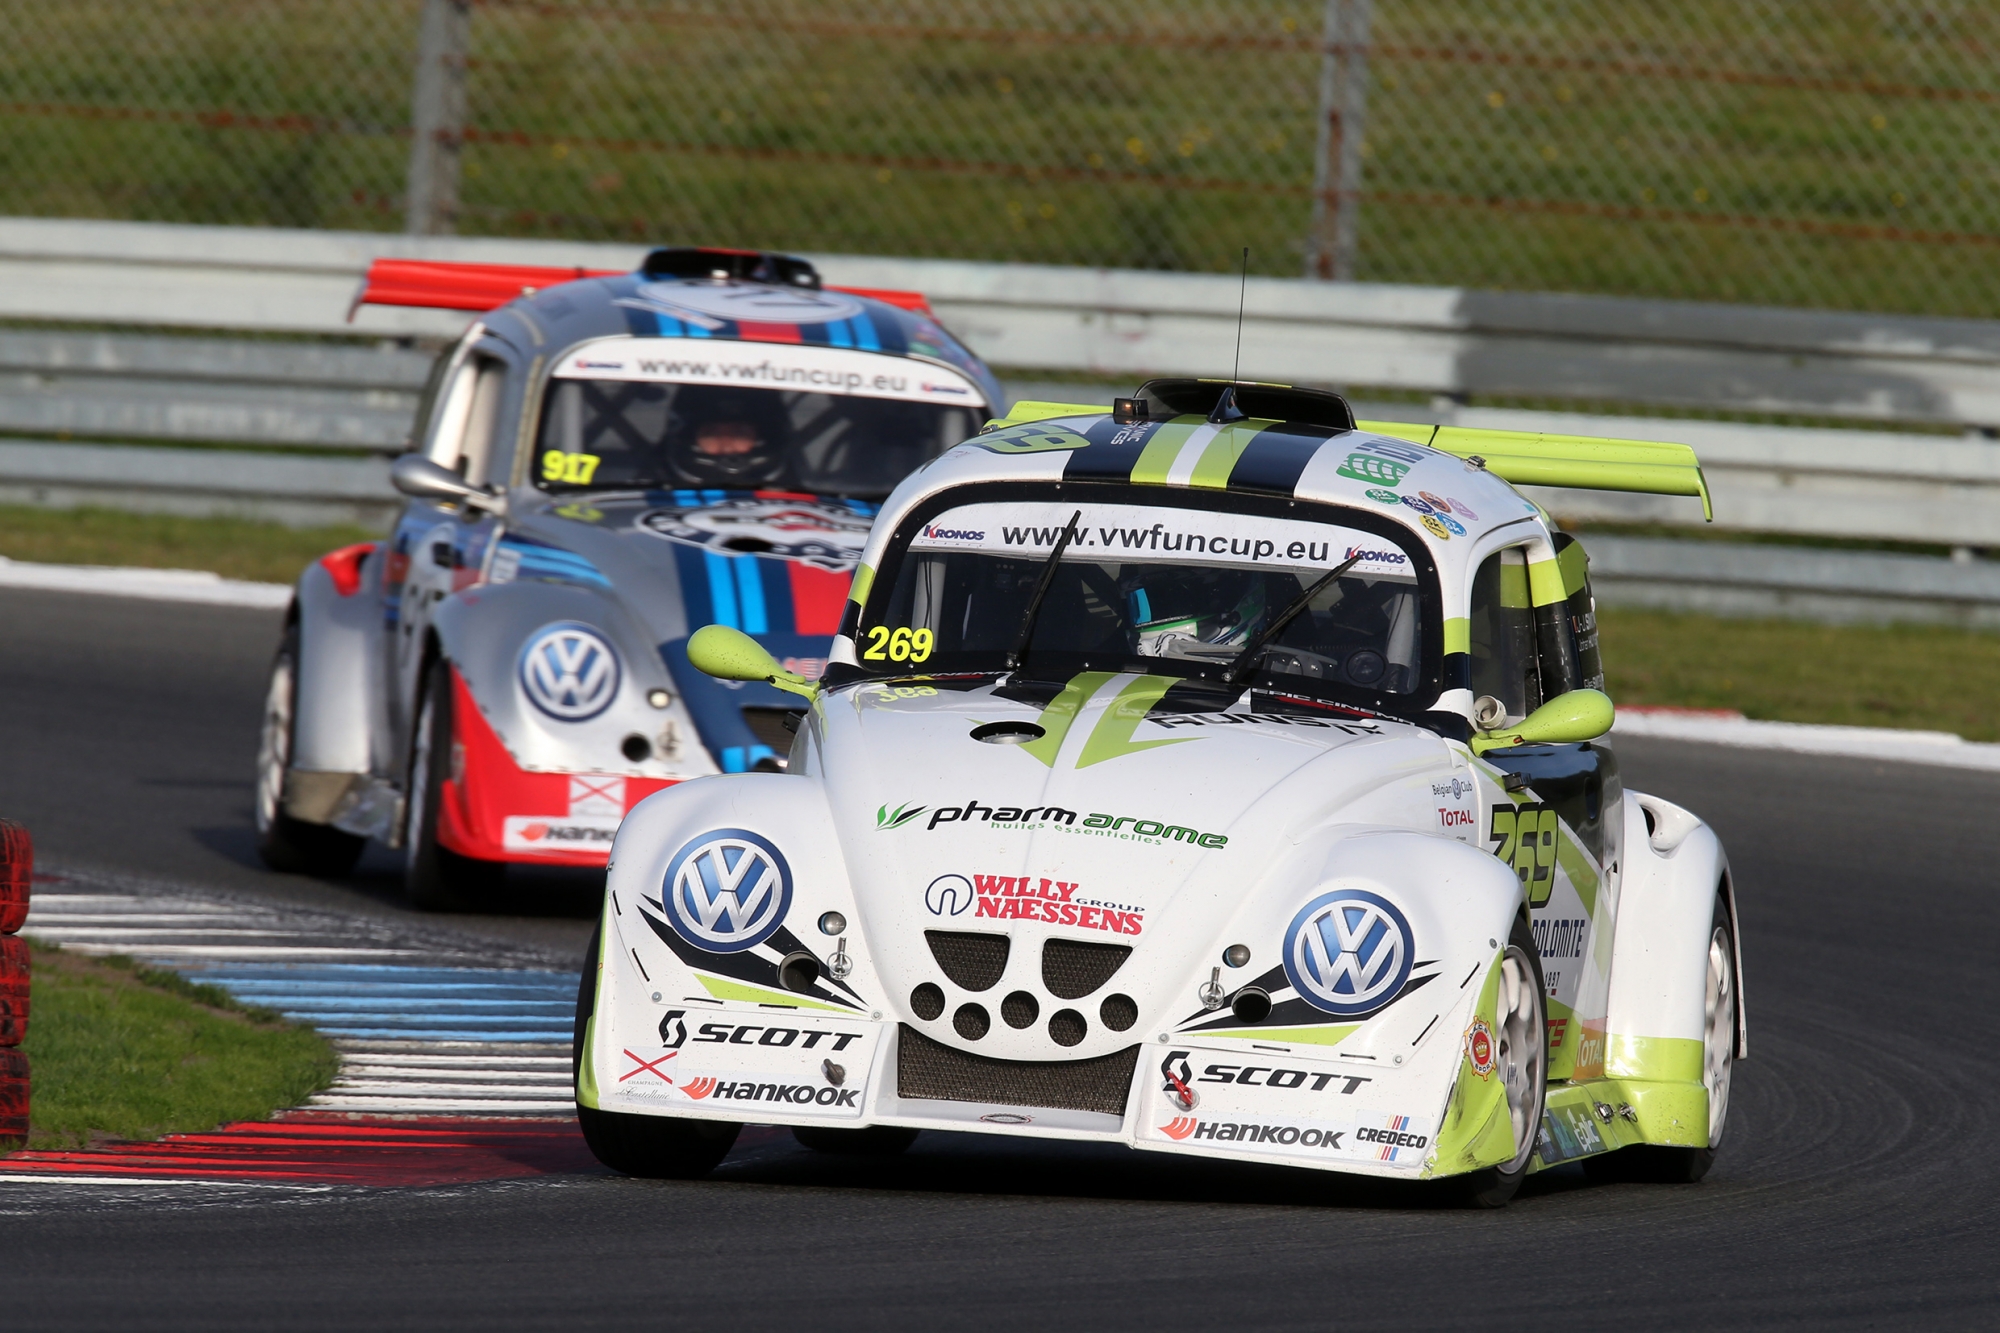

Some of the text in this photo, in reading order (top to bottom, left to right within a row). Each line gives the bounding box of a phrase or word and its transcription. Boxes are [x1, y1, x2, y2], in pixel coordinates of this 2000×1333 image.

[637, 356, 907, 395] www.vwfuncup.eu
[542, 450, 600, 485] 917
[922, 522, 985, 540] KRONOS
[1002, 523, 1329, 562] www.vwfuncup.eu
[1344, 544, 1406, 564] KRONOS
[864, 626, 934, 663] 269
[1251, 687, 1311, 701] EPIC
[927, 800, 1229, 849] pharm arome
[1438, 808, 1474, 827] TOTAL
[990, 821, 1163, 847] huiles essentielles
[973, 874, 1079, 902] WILLY
[974, 896, 1144, 936] NAESSENS
[1075, 898, 1146, 912] GROUP
[691, 1023, 864, 1051] SCOTT
[1197, 1064, 1373, 1095] SCOTT
[1356, 1127, 1428, 1150] CREDECO
